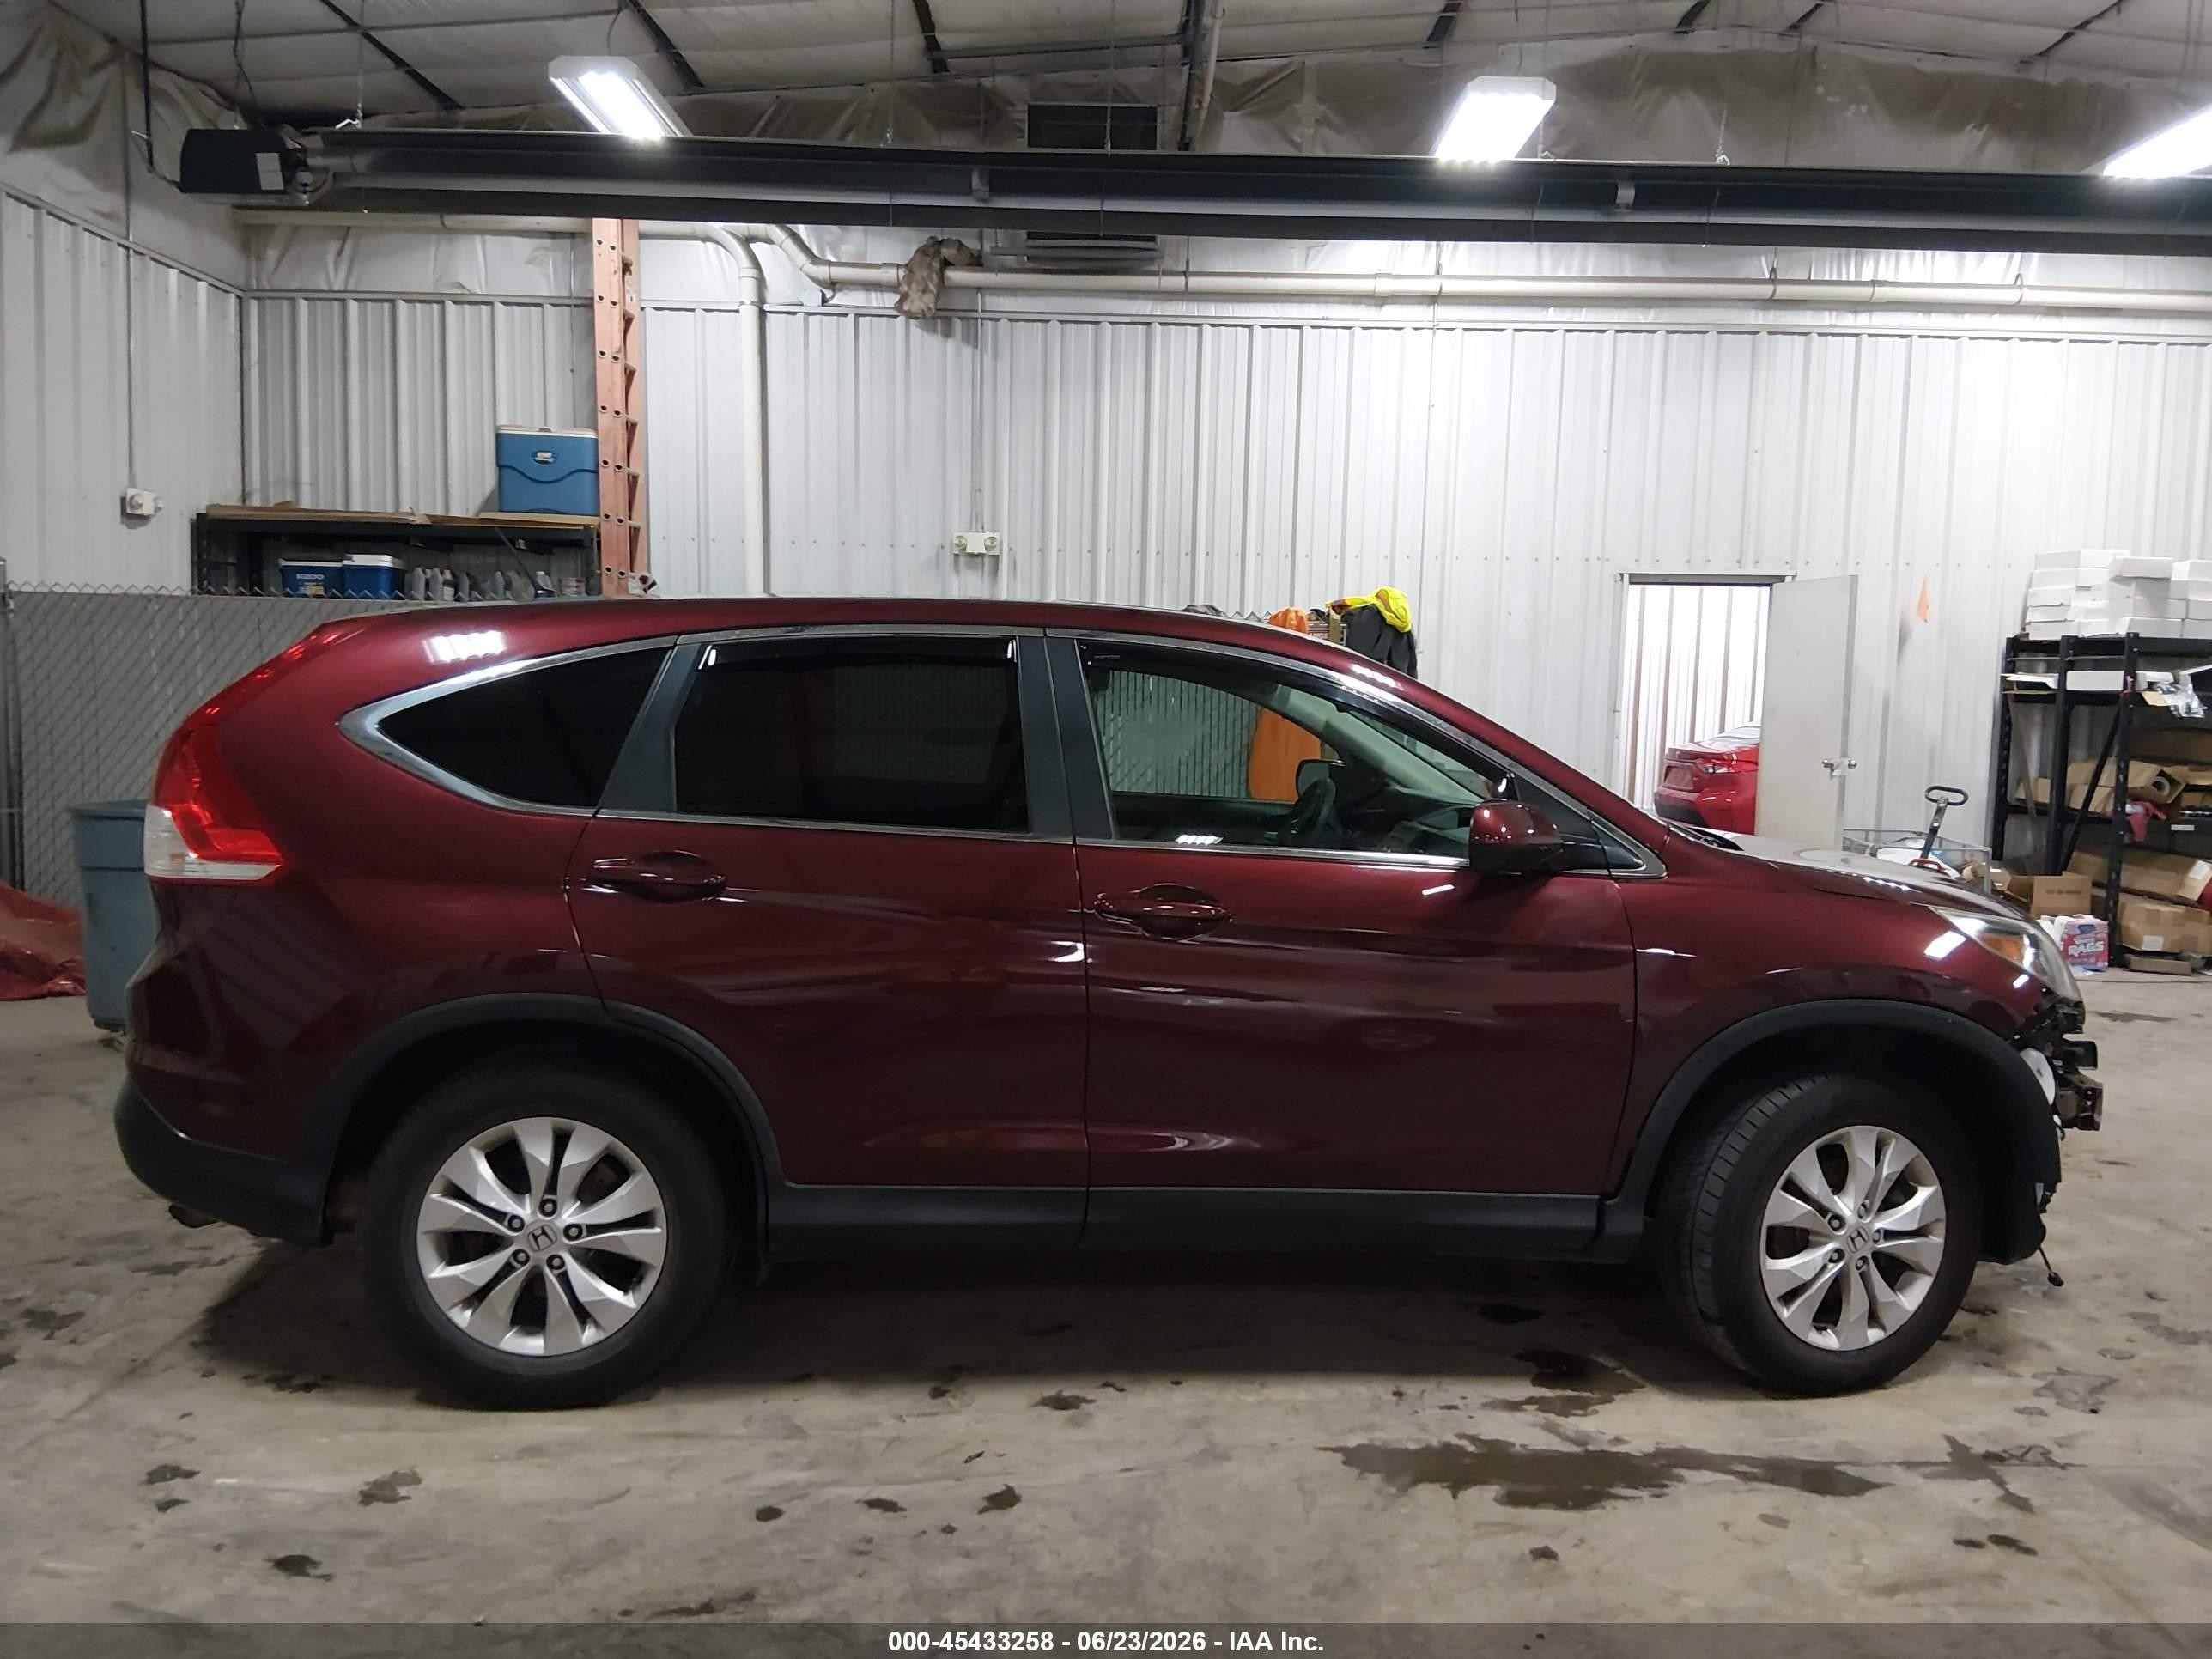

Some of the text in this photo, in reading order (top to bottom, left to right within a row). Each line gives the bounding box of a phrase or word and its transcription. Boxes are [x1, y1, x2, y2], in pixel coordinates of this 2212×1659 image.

[2068, 940, 2104, 957] RAGS
[531, 1225, 555, 1250] H
[1849, 1229, 1868, 1251] H
